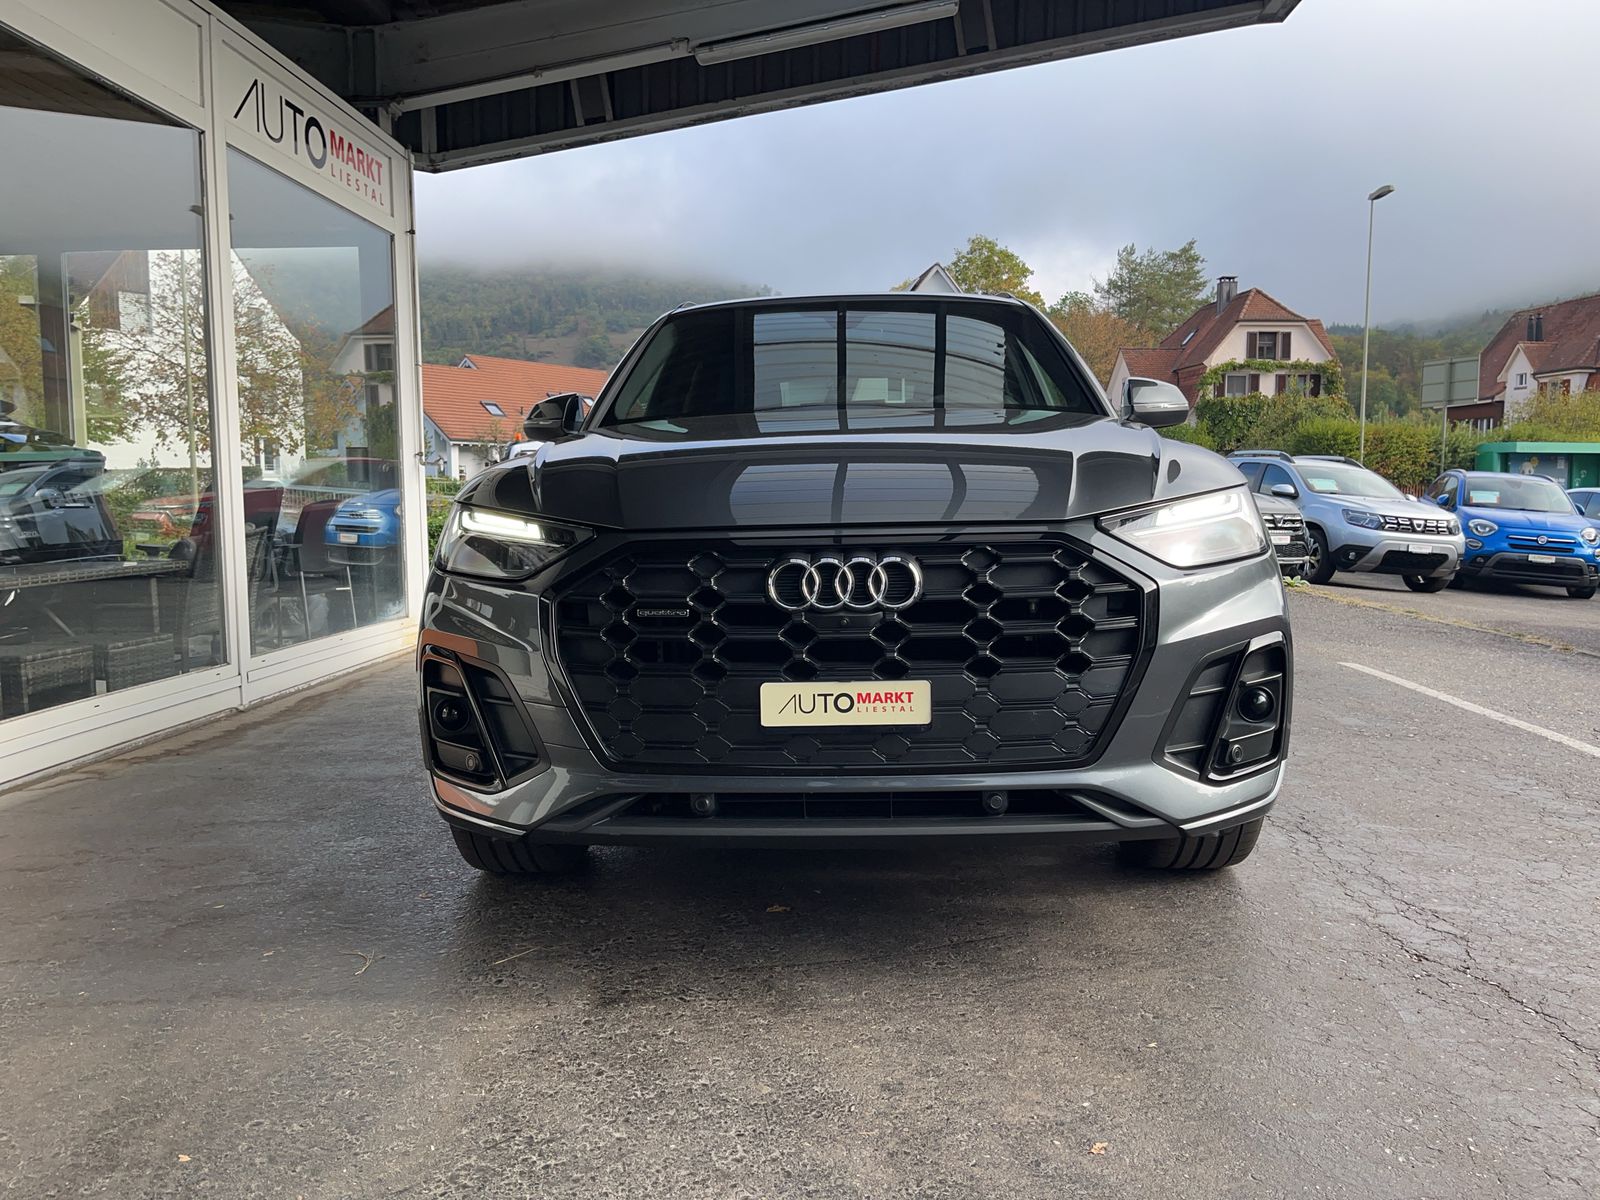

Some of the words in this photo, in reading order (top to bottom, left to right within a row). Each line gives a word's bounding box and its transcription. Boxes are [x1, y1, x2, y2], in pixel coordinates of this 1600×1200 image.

[233, 78, 328, 170] AUTO
[329, 129, 383, 186] MARKT
[330, 163, 385, 206] LIESTAL
[778, 692, 855, 714] AUTO
[856, 691, 914, 704] MARKT
